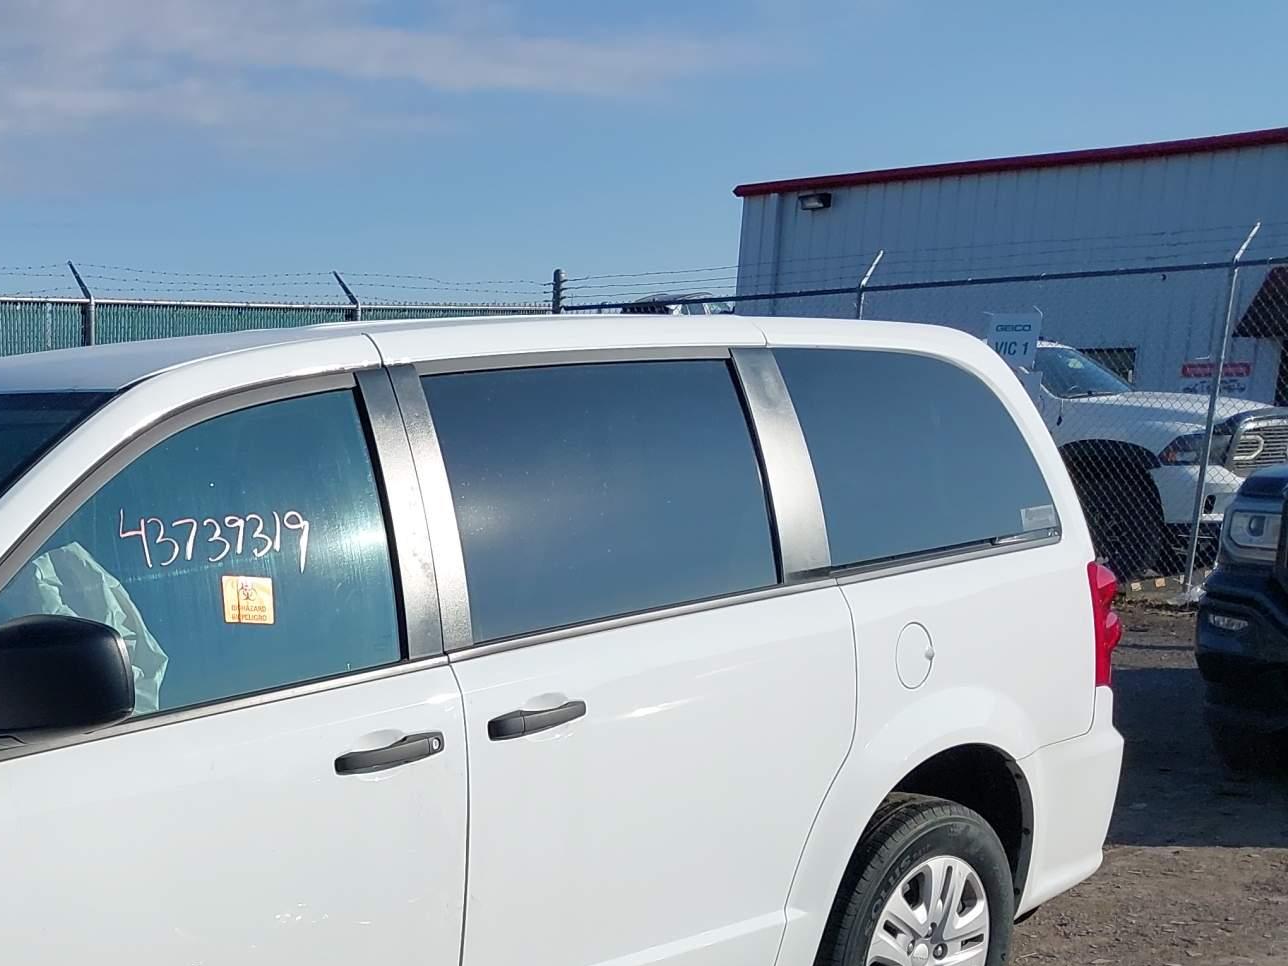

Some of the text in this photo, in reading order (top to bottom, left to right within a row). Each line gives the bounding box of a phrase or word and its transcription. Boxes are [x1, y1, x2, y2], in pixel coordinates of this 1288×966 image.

[995, 341, 1029, 355] VIC 1
[119, 508, 310, 574] 43739319
